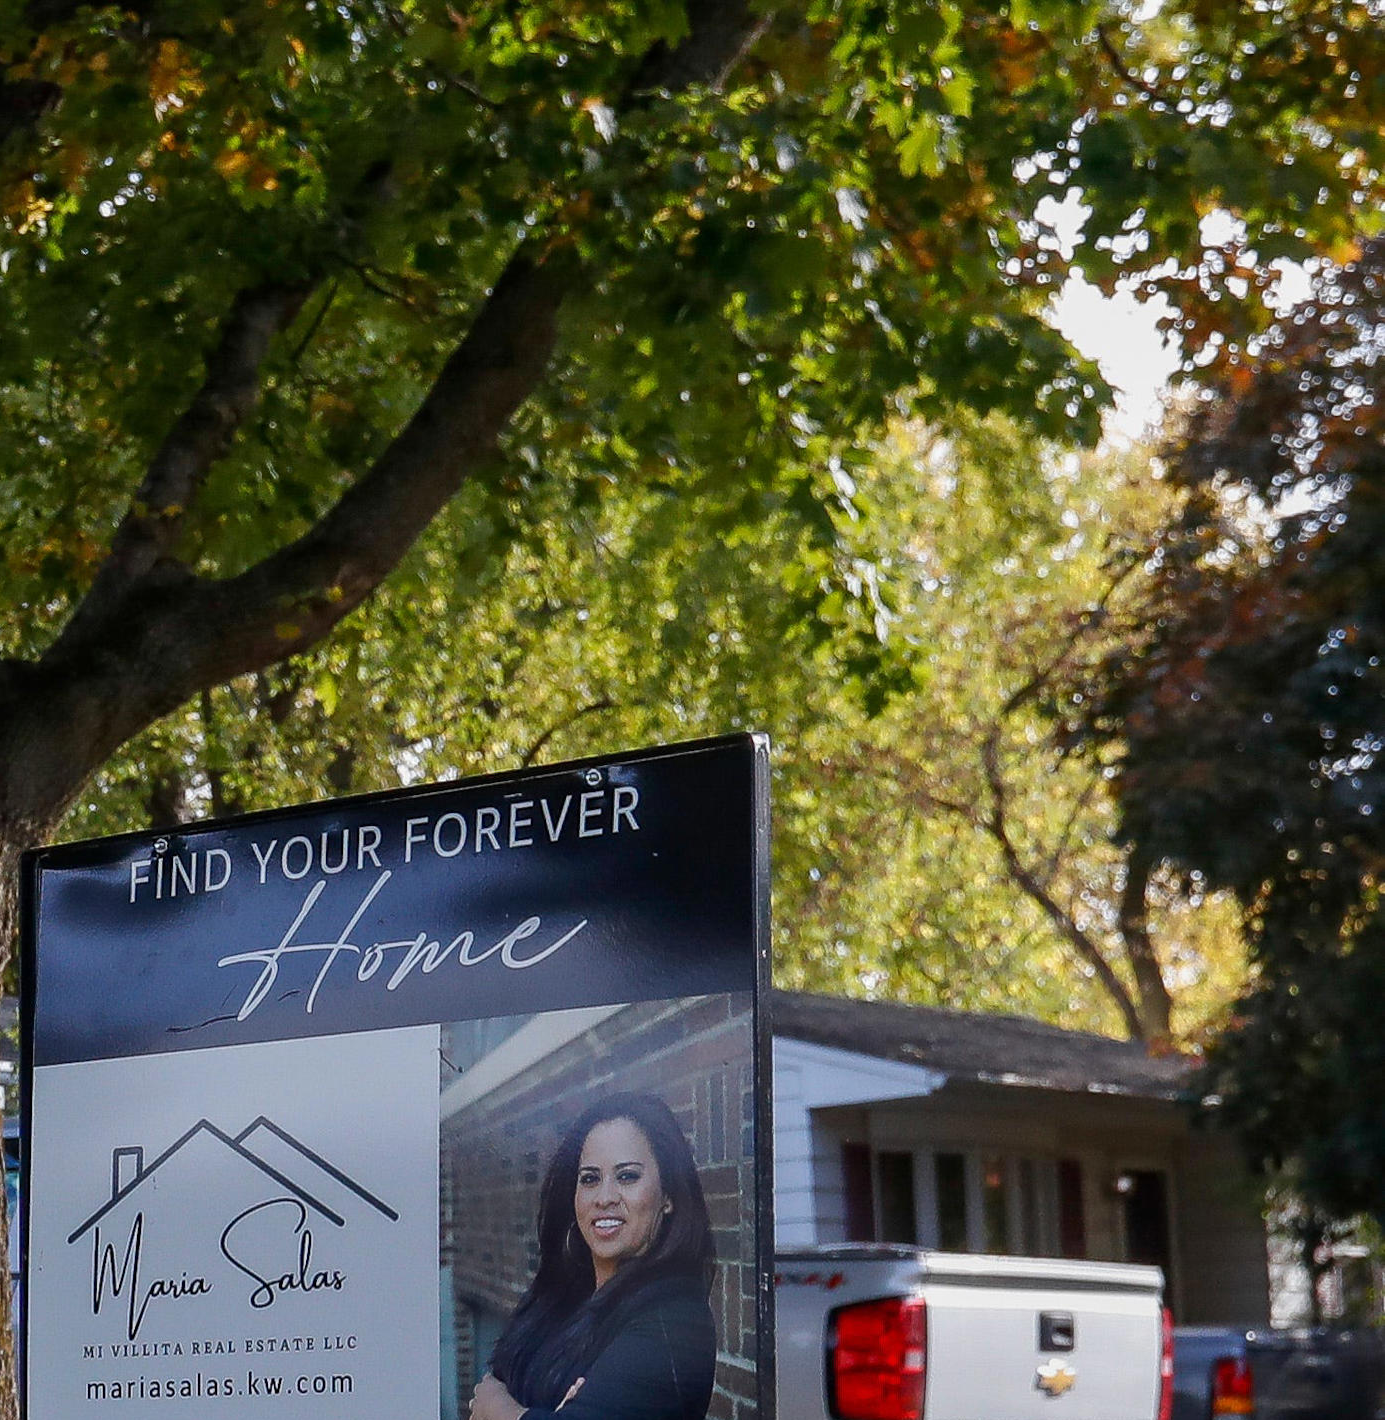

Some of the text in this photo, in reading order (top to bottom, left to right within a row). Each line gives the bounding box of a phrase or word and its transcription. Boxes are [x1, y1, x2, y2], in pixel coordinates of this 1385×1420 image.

[129, 786, 641, 903] FIND YOUR FOREVER
[217, 871, 588, 1023] Home
[92, 1197, 347, 1342] Maria Salas
[83, 1335, 358, 1359] MI VILLITA REAL ESTATE LLC
[87, 1371, 354, 1400] mariasalas.kw.com
